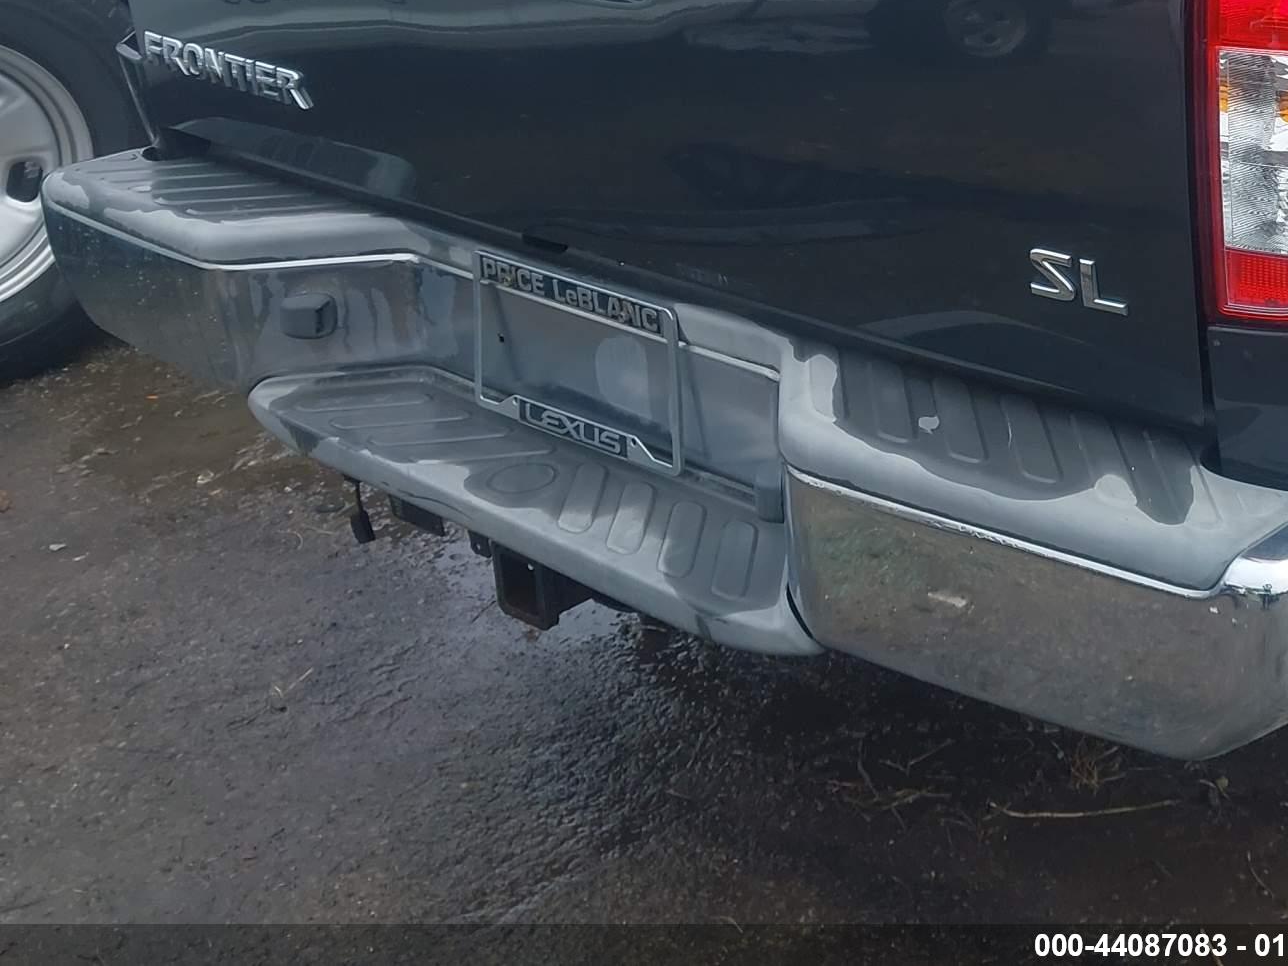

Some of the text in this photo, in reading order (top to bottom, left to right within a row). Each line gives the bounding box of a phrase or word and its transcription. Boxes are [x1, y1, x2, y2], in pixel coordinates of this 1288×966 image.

[144, 30, 314, 110] FRONTIER
[481, 257, 660, 333] PRICE LeBLANC
[1029, 247, 1129, 316] SL
[523, 402, 622, 455] LEXUS
